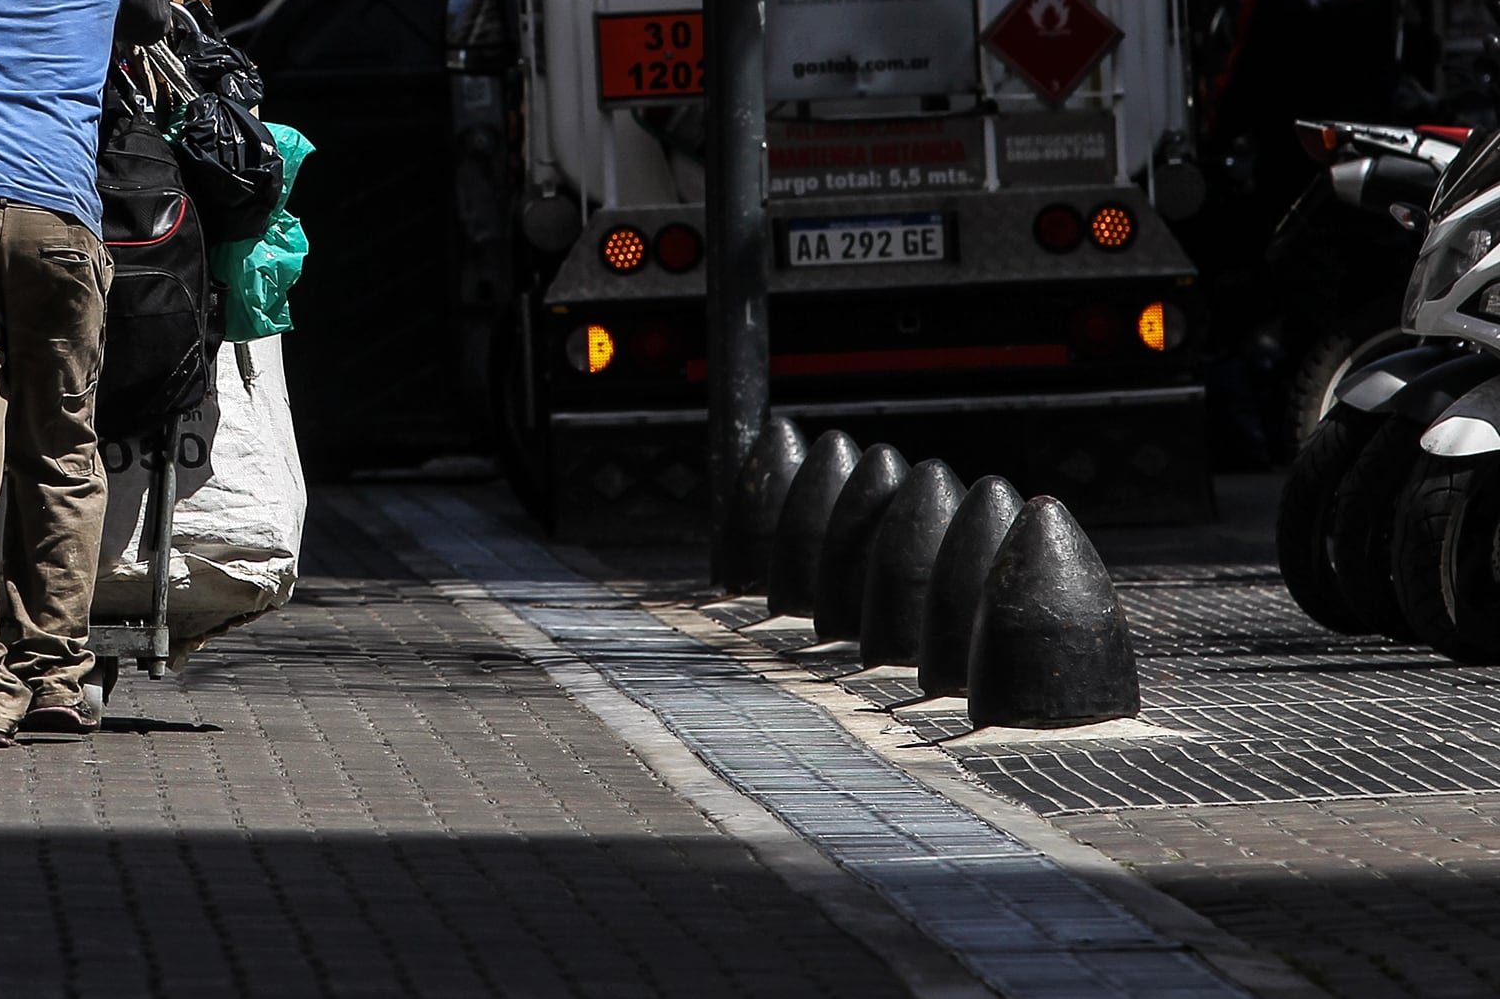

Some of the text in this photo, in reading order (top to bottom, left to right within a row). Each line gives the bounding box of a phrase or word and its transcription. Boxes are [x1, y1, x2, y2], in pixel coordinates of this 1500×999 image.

[644, 21, 691, 50] 30
[793, 55, 930, 79] gastab.com.ar
[771, 168, 974, 195] argo total: 5,5 mts.
[797, 229, 937, 260] AA 292 GE
